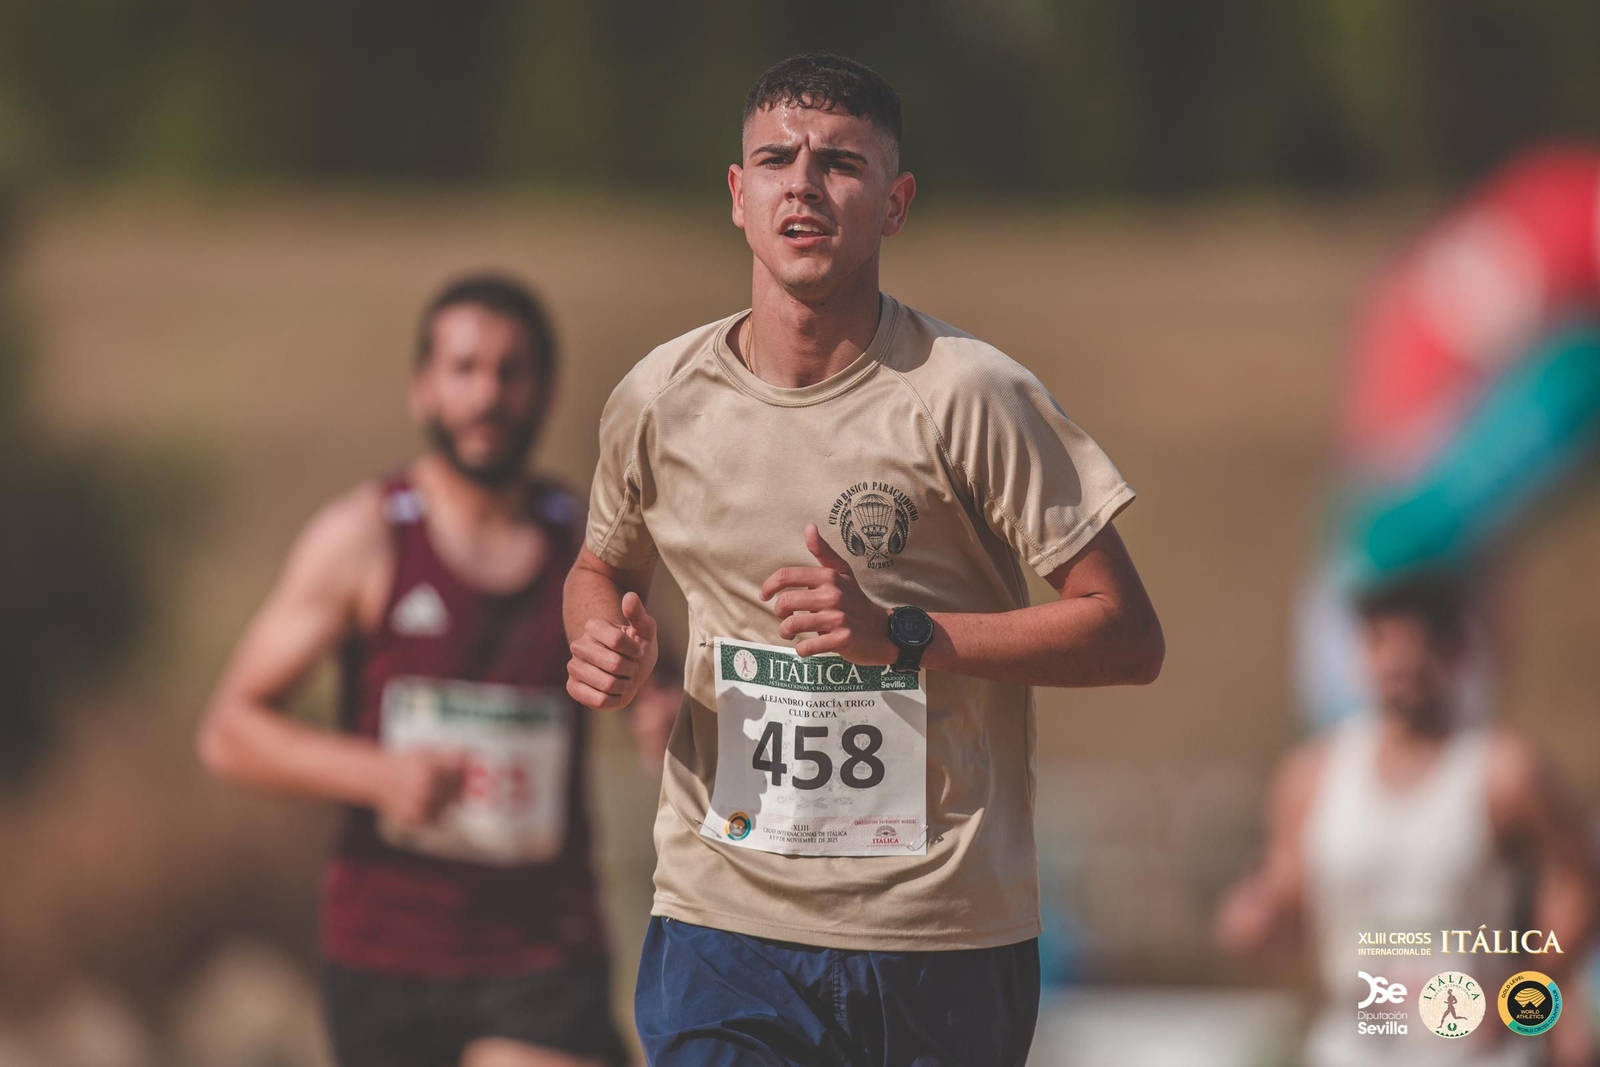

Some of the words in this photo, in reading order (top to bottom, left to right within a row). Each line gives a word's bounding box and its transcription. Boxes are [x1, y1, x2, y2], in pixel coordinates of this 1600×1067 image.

[829, 498, 844, 525] CURSO
[840, 481, 868, 501] BASICO
[872, 481, 919, 522] PARACAIDISMO
[881, 681, 906, 689] Sevilla
[760, 694, 804, 707] ALEJANDRO
[805, 698, 842, 708] GARCÍA
[844, 699, 875, 708] TRIGO
[788, 709, 810, 718] CLUB
[752, 721, 885, 790] 458
